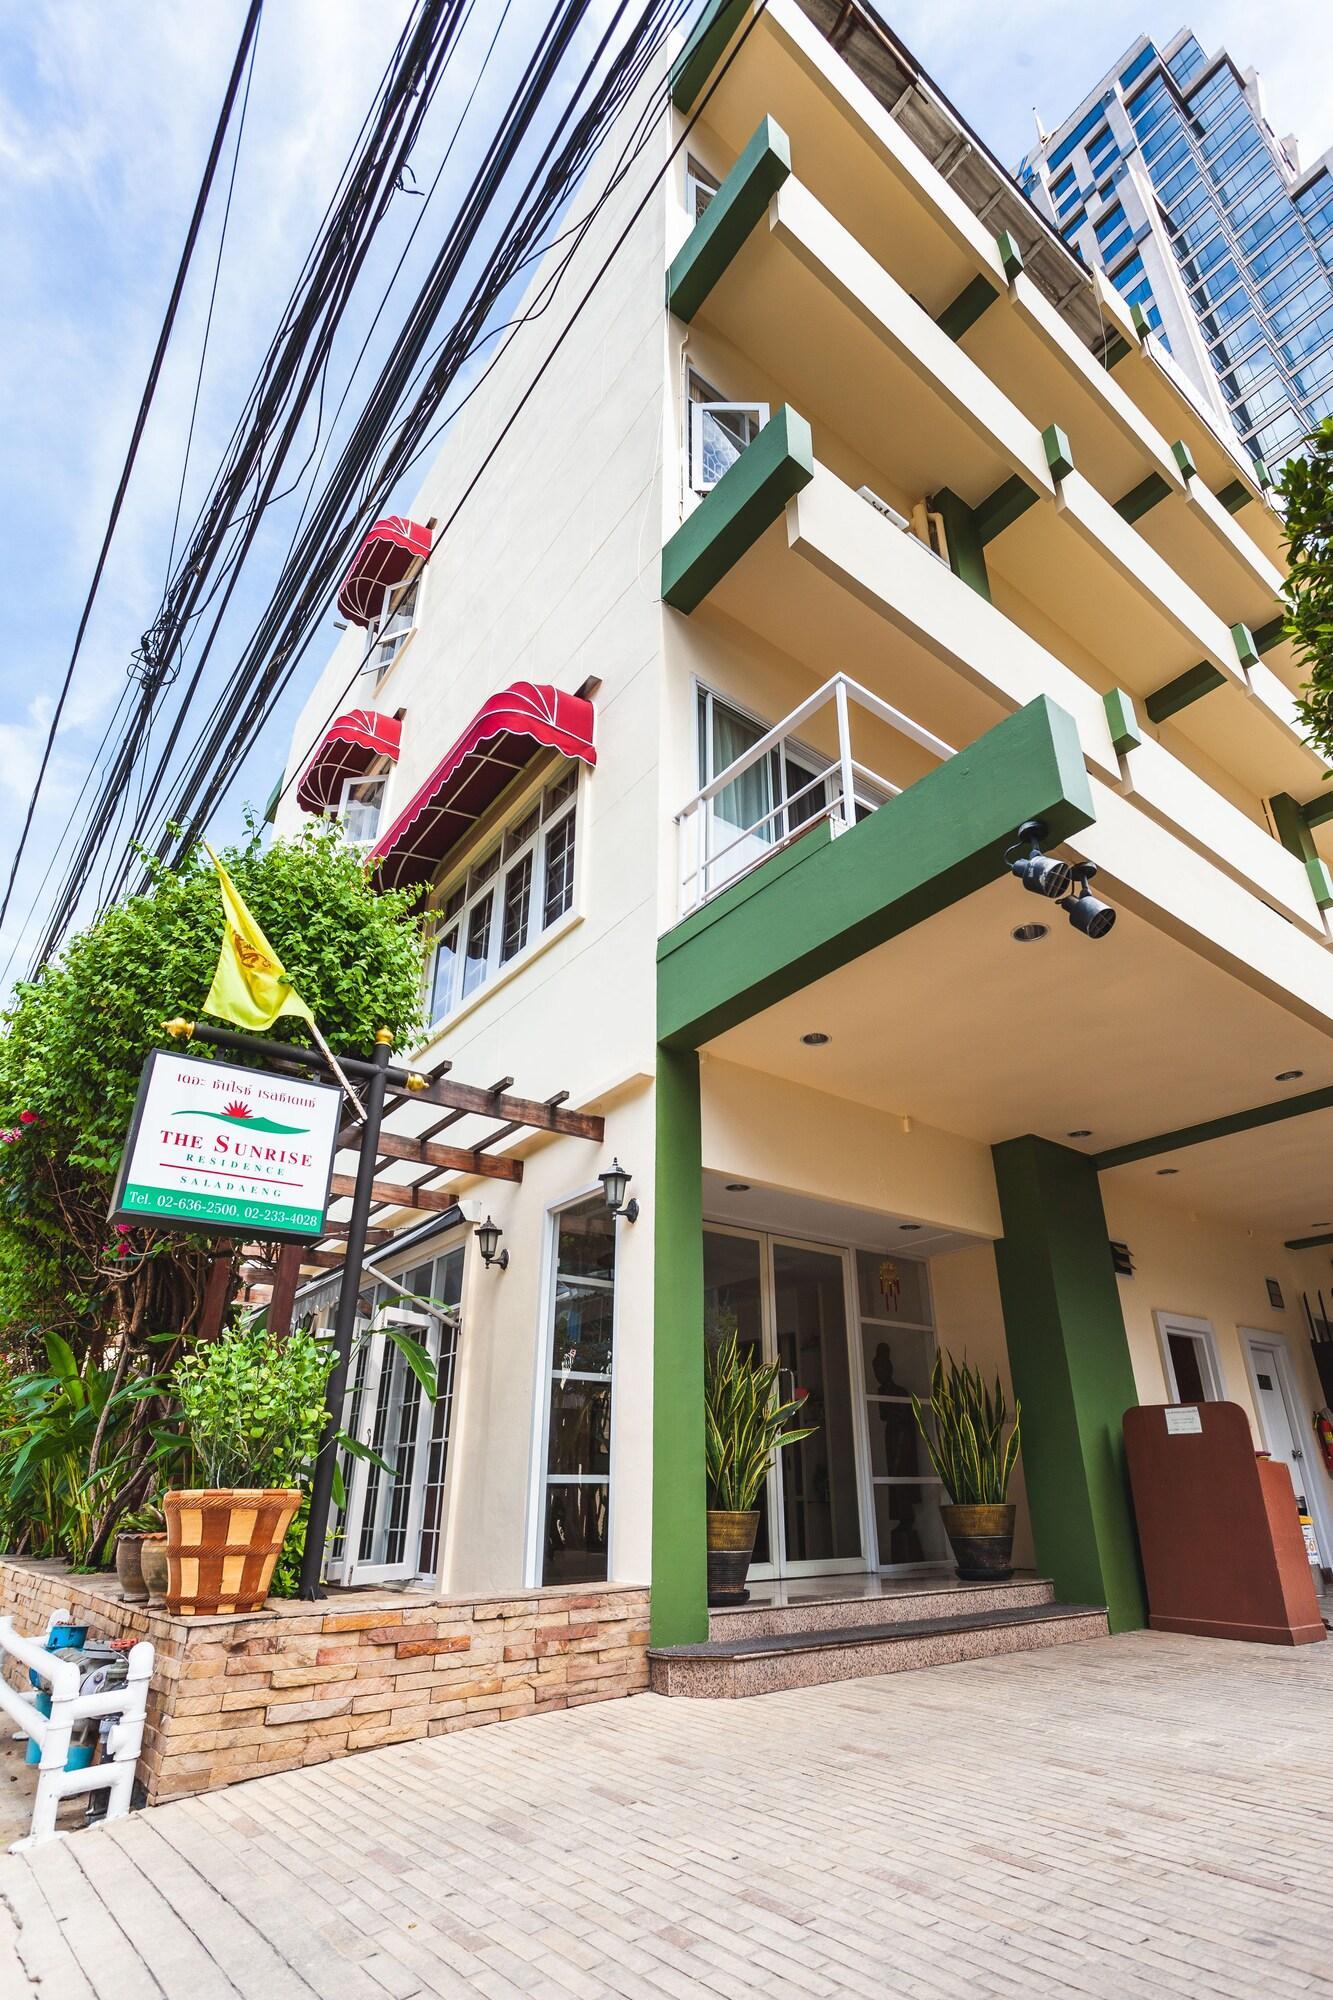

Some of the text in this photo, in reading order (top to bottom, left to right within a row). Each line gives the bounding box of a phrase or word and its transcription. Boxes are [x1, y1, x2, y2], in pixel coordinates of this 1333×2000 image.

[160, 1130, 203, 1149] THE
[186, 1153, 285, 1176] RESIDENCE
[179, 1175, 281, 1197] SALADAENG
[130, 1191, 151, 1205] Tel.
[244, 1207, 317, 1227] 02-233-4028
